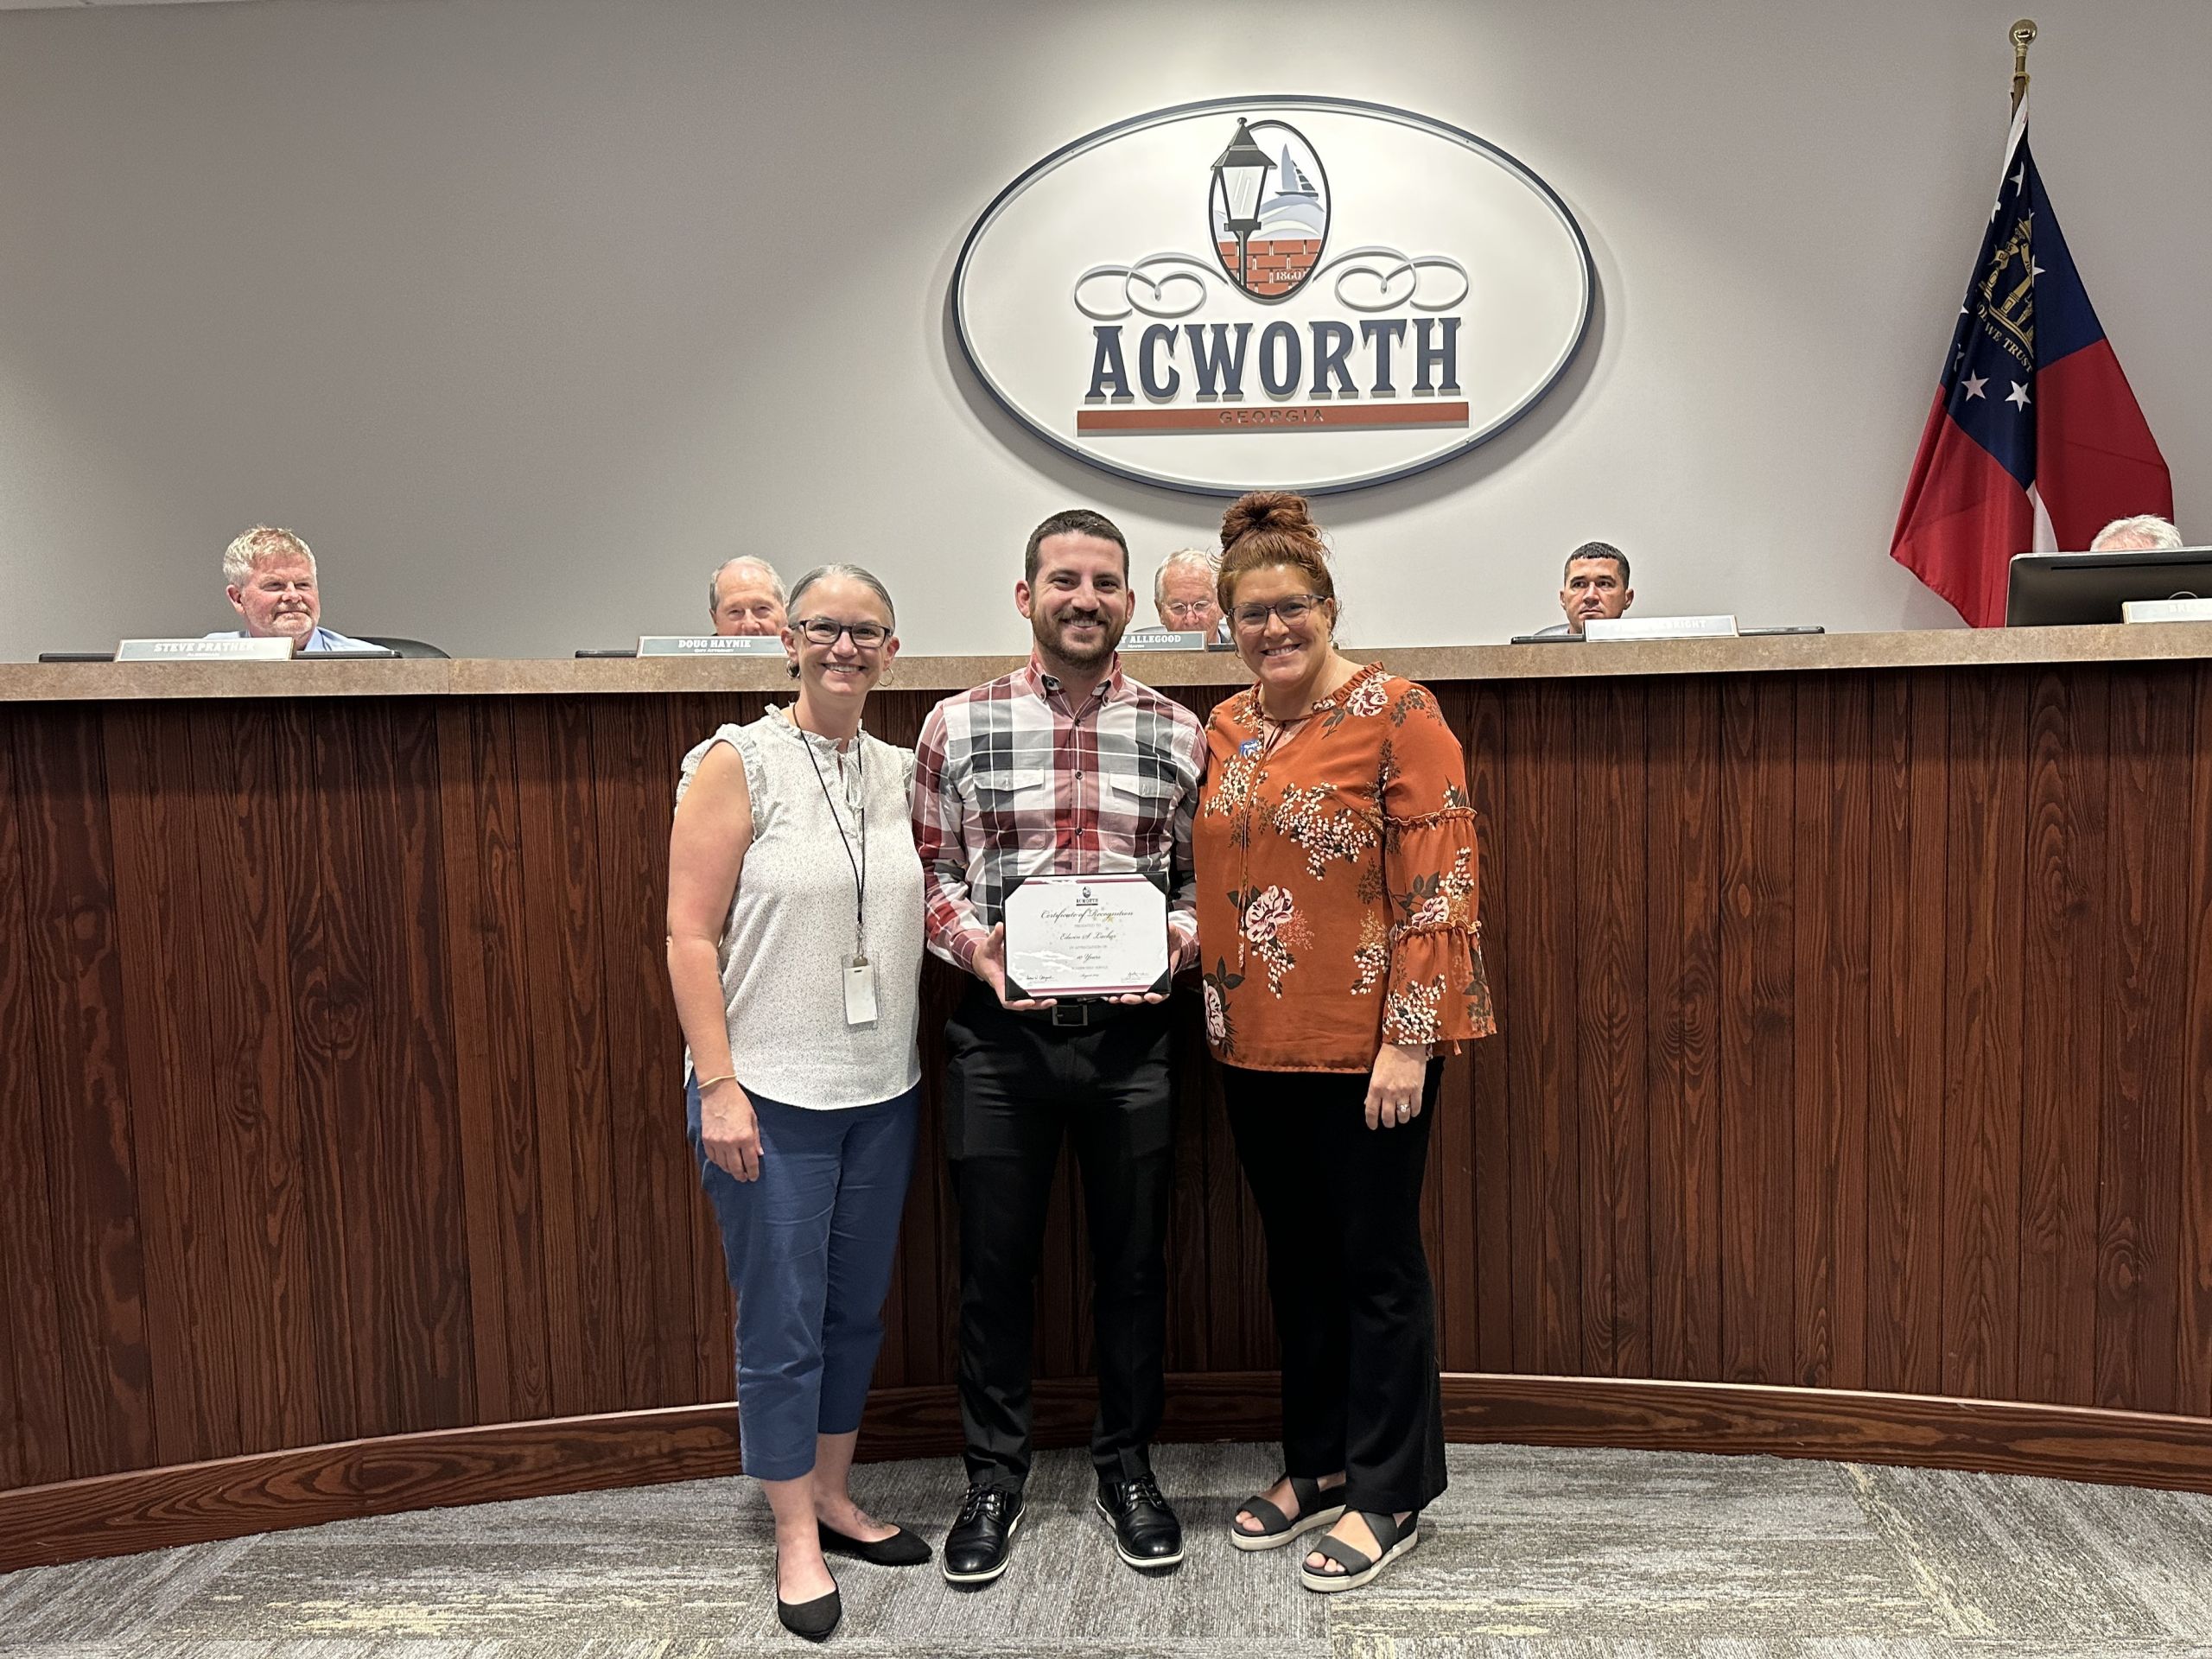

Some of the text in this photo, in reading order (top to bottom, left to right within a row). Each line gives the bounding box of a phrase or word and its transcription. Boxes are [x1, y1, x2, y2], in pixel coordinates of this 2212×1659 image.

[1275, 270, 1302, 281] 1860
[1985, 322, 2003, 341] WE
[2003, 337, 2033, 372] TRUST
[1084, 317, 1462, 401] ACWORTH
[1218, 409, 1324, 423] GEORGIA
[677, 639, 752, 648] DOUG HAYNIE
[1129, 634, 1182, 644] ALLEGOOD
[153, 643, 195, 652] STEVE
[1040, 908, 1134, 924] Certificate of Recognition
